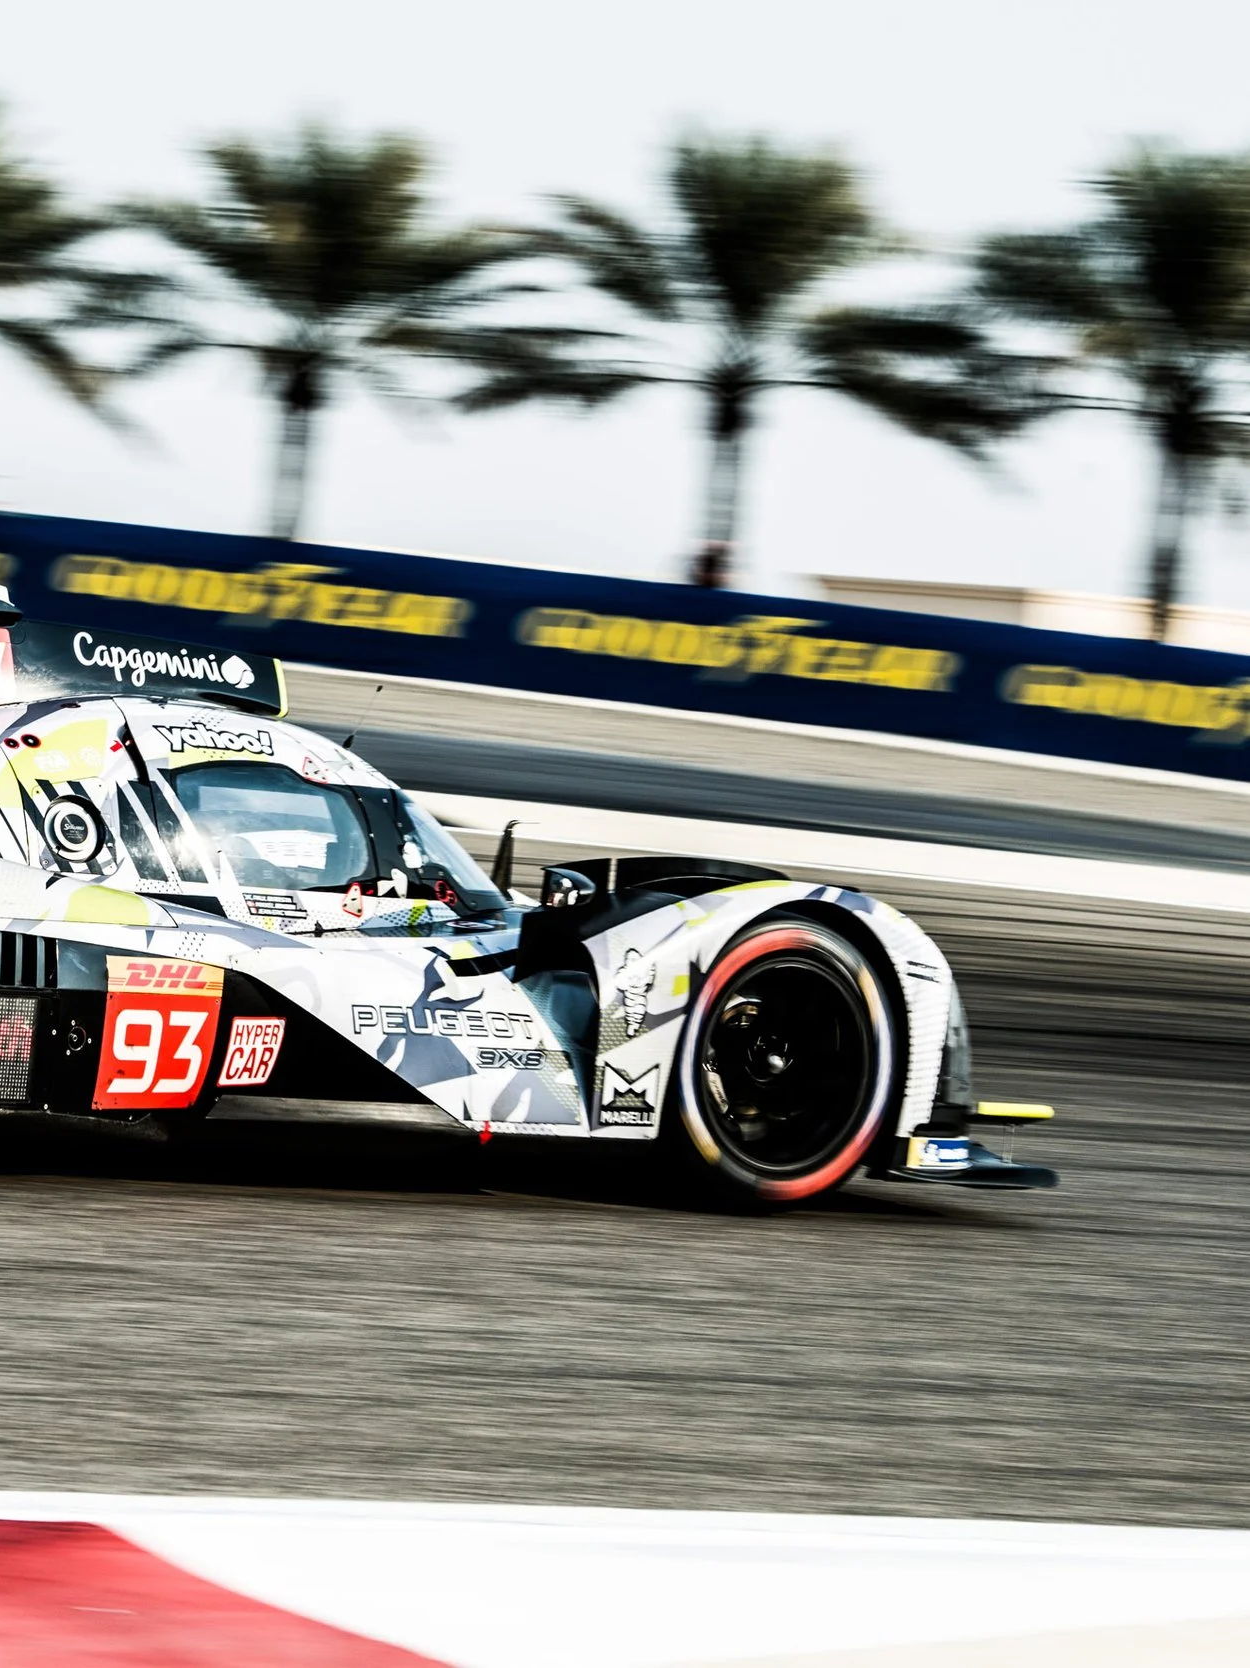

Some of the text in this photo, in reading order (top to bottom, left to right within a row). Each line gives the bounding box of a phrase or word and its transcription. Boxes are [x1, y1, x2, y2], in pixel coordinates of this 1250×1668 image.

[73, 631, 225, 687] Capgemini
[152, 721, 275, 756] yahoo!
[125, 962, 210, 989] DHL
[234, 1024, 280, 1045] HYPER
[351, 1004, 533, 1040] PEUGEOT
[106, 1009, 209, 1094] 93
[225, 1045, 273, 1081] CAR
[476, 1047, 547, 1070] 9X8
